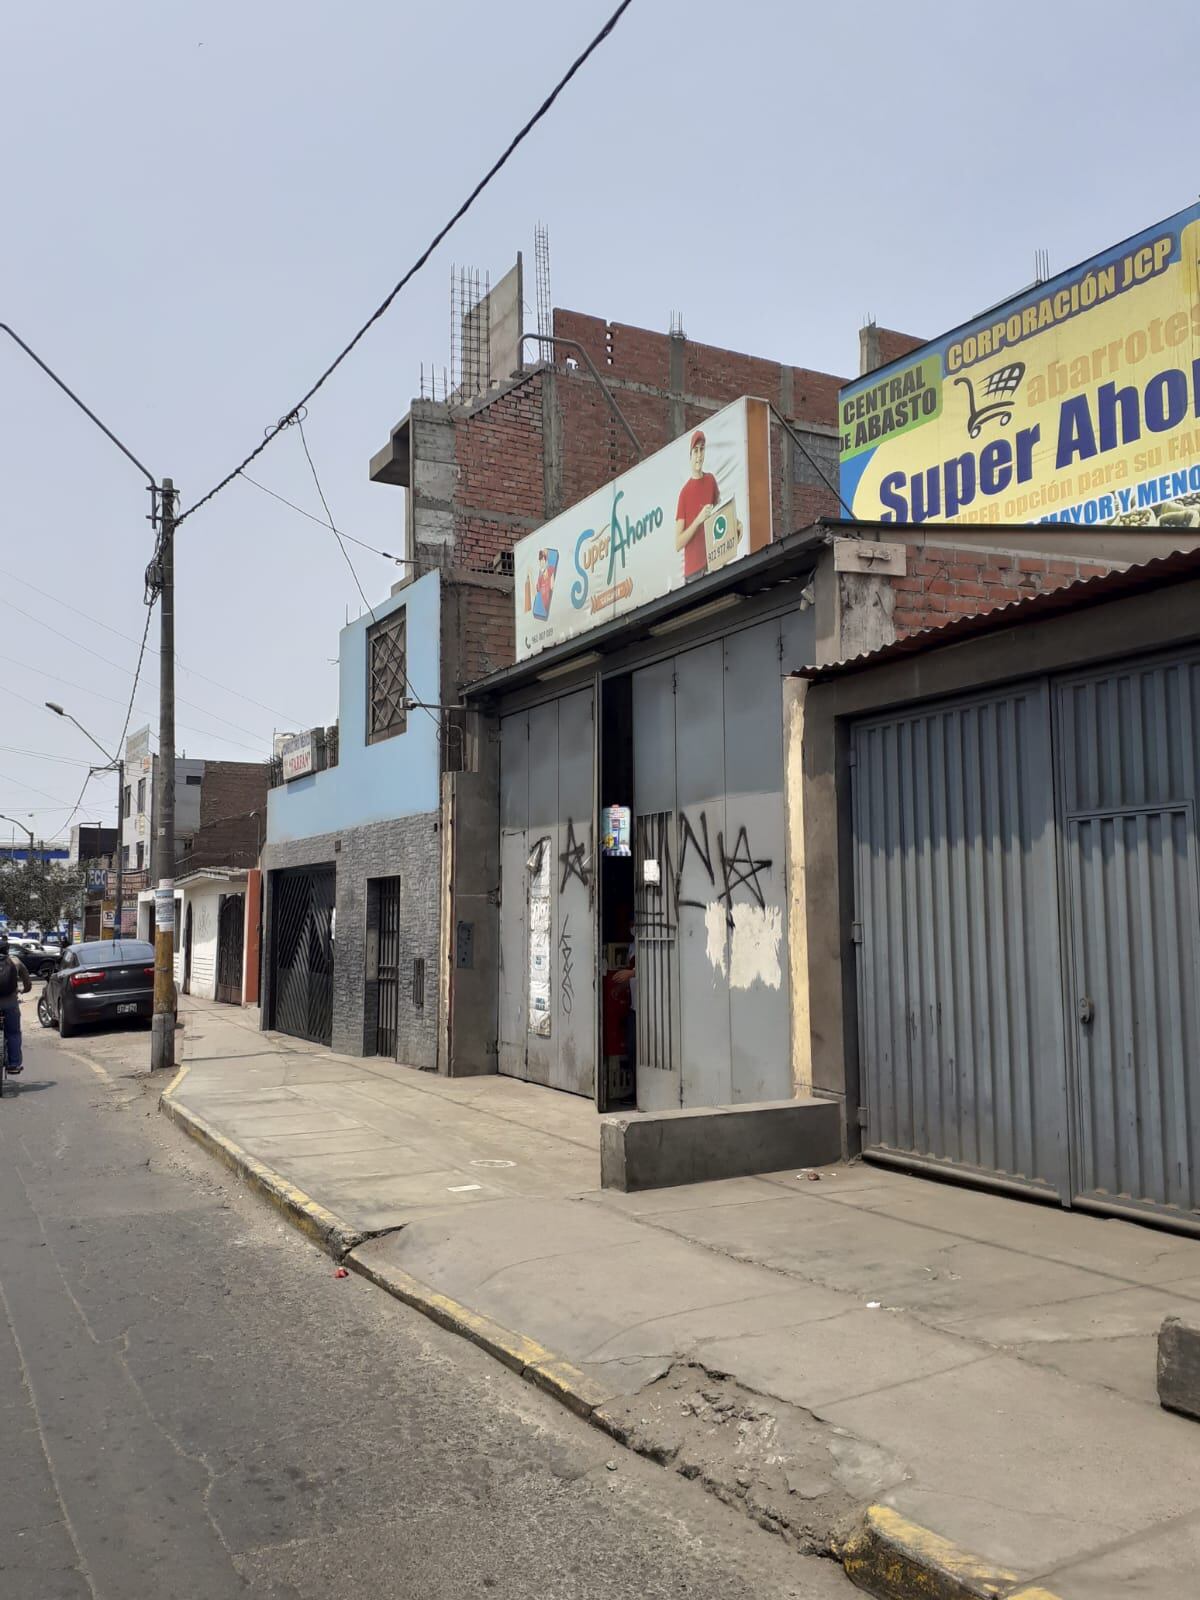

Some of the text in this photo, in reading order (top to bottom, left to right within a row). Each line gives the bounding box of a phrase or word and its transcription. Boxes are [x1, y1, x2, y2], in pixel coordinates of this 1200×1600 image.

[948, 238, 1172, 370] CORPORACIÓN JCP
[843, 366, 925, 425] CENTRAL
[855, 387, 937, 448] ABASTO
[880, 423, 1041, 524] Super
[1004, 481, 1073, 517] opción
[1079, 459, 1129, 496] para
[1134, 447, 1162, 473] su
[1117, 488, 1133, 513] Y
[607, 491, 663, 585] Ahorro
